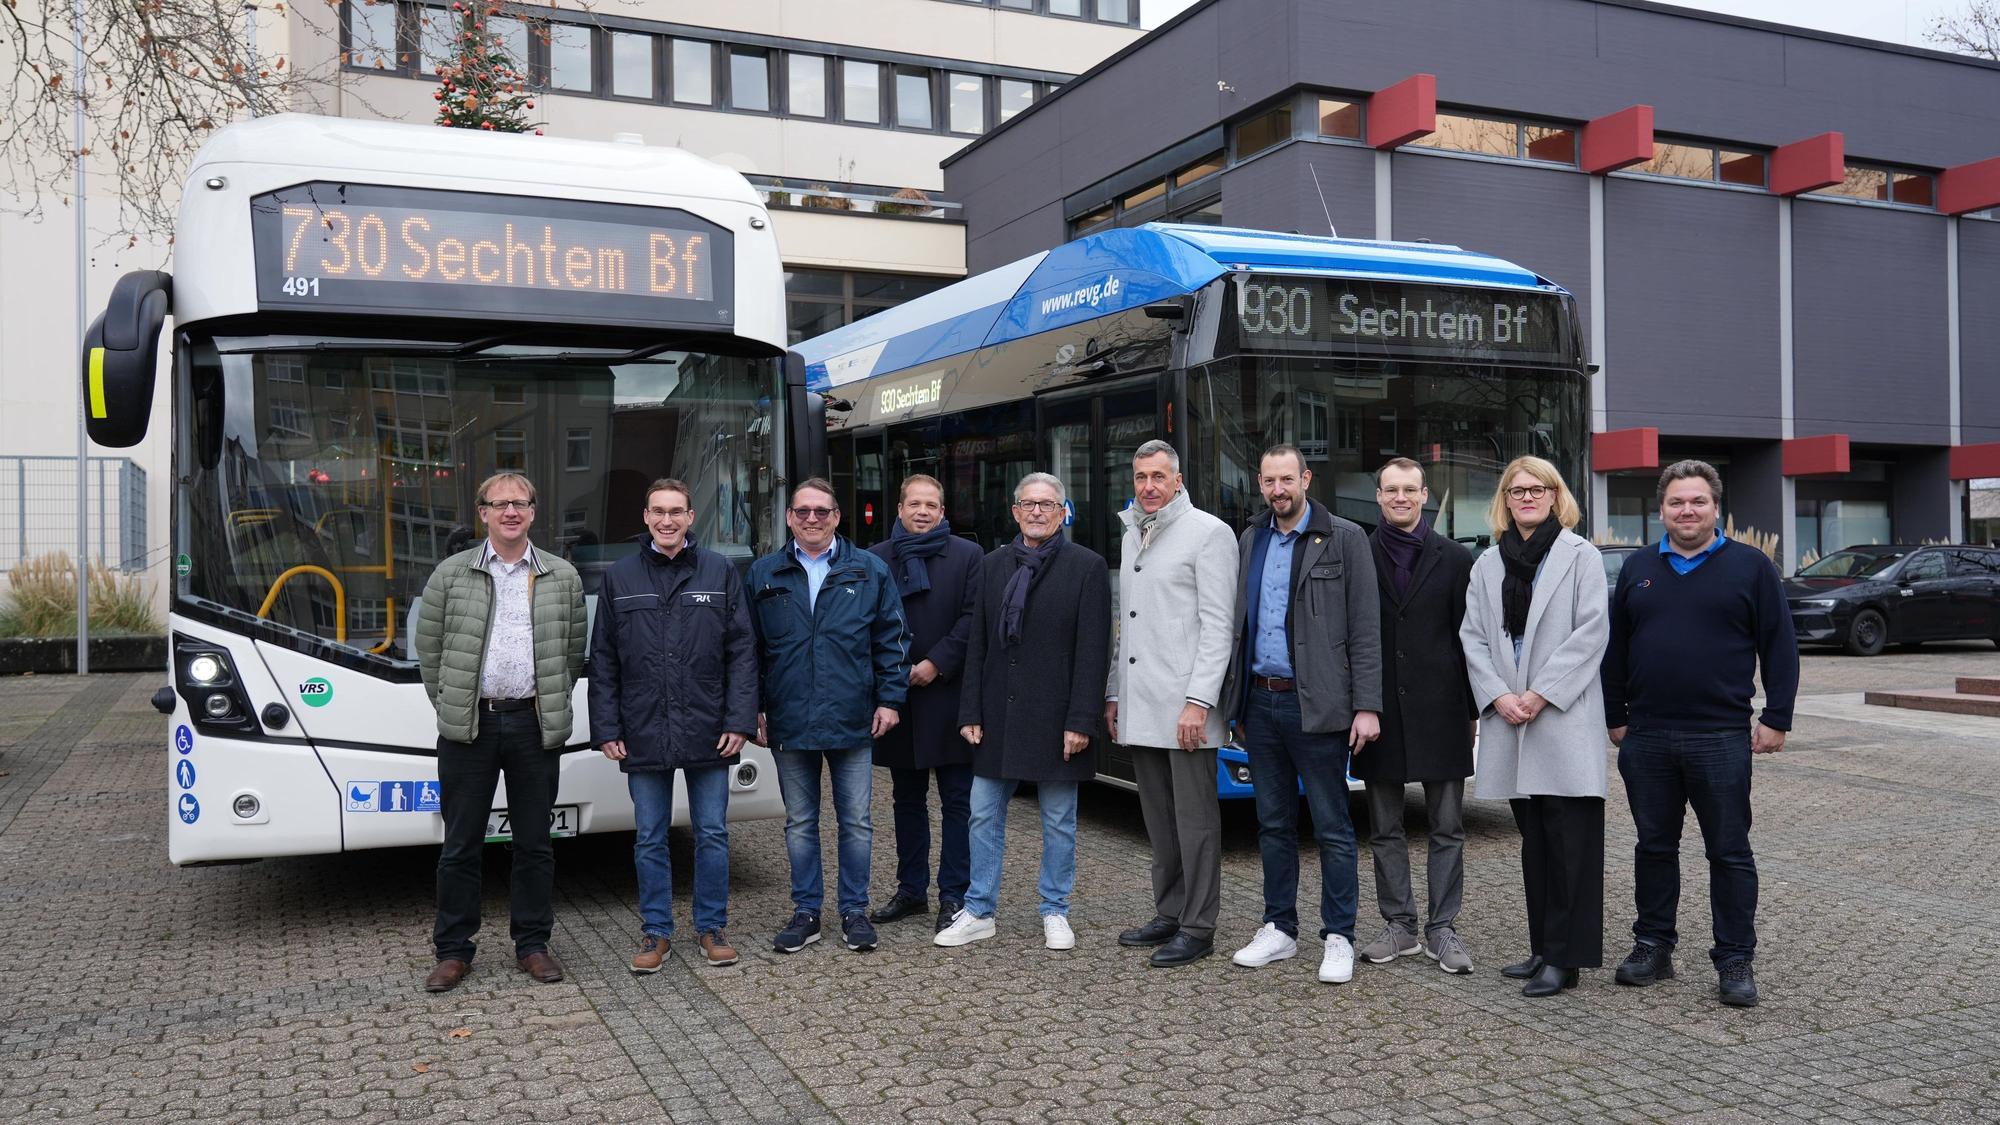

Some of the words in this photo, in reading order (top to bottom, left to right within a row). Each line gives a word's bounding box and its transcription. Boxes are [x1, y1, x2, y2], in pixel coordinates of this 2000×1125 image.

[283, 207, 387, 275] 730
[401, 216, 625, 289] Sechtem
[649, 233, 702, 294] Bf
[282, 278, 320, 297] 491
[1041, 274, 1120, 315] www.revg.de
[1242, 284, 1312, 336] 930
[1338, 293, 1483, 342] Sechtem
[1493, 303, 1528, 344] Bf
[880, 388, 896, 414] 930
[896, 384, 930, 409] Sechtem
[931, 379, 942, 402] Bf
[299, 683, 325, 694] VRS
